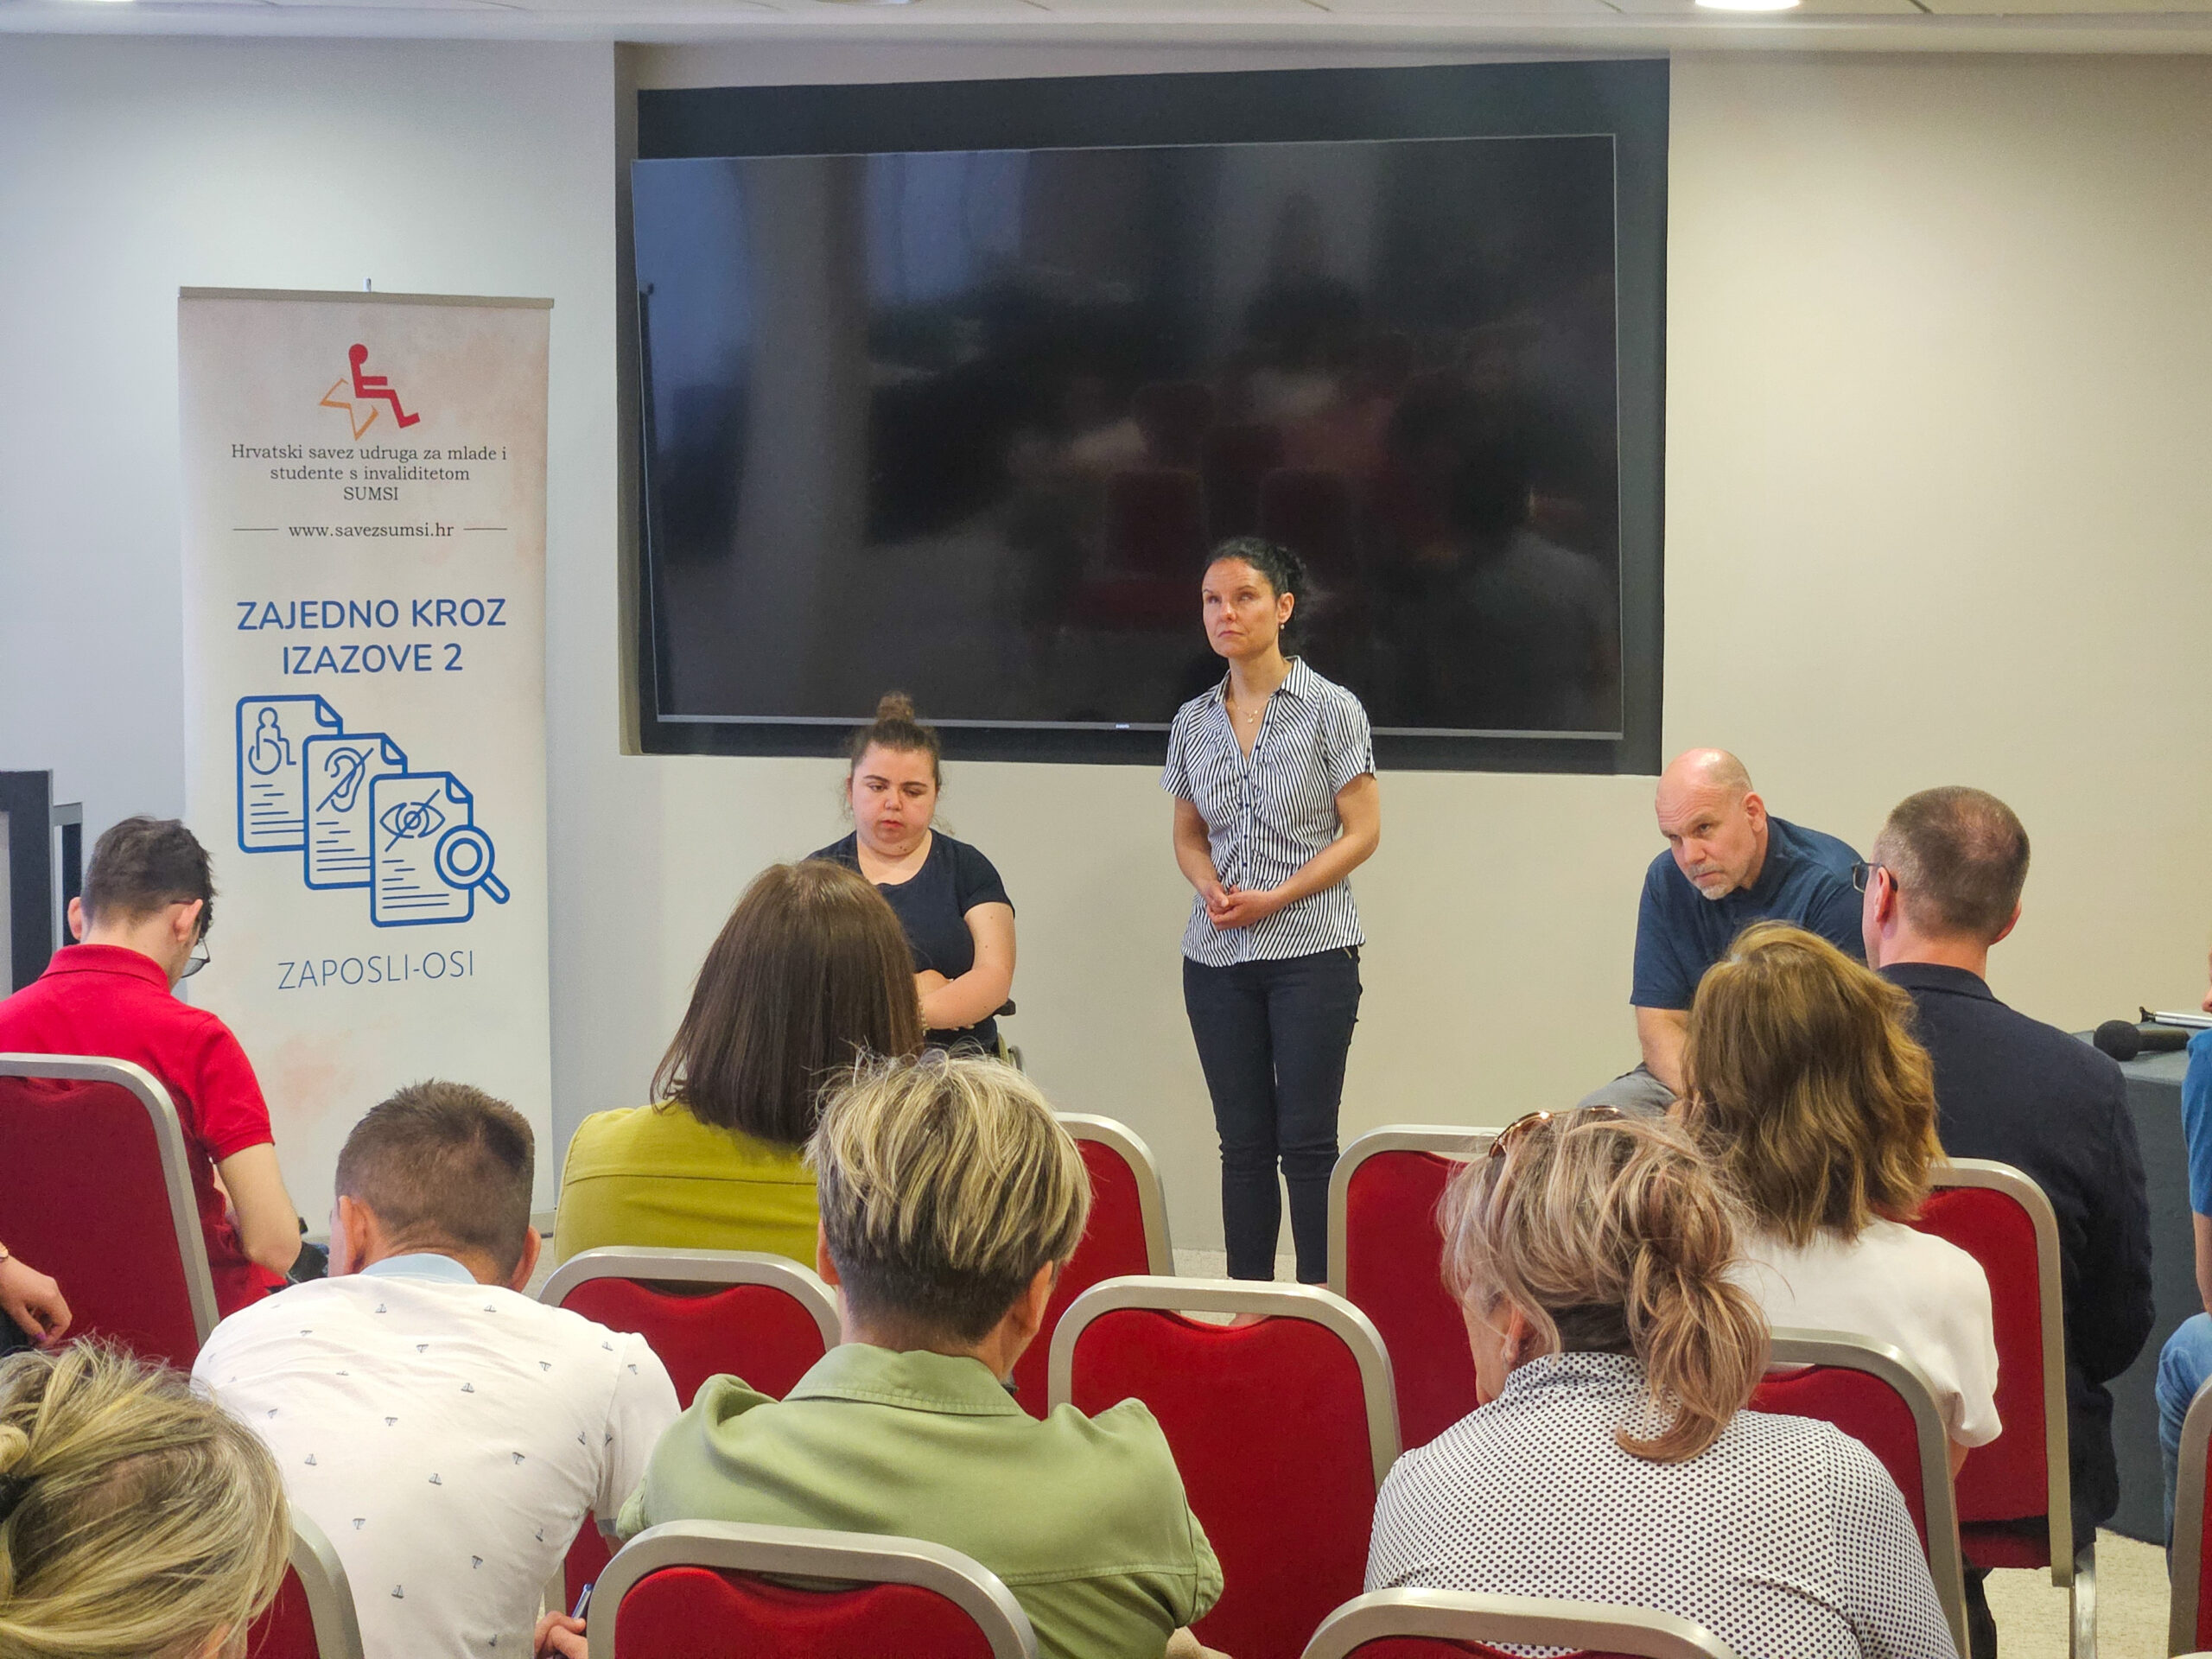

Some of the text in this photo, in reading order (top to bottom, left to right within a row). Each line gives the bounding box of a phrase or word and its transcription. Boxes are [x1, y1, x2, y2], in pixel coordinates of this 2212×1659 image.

[231, 444, 507, 464] Hrvatski savez udruga za mlade i
[270, 466, 470, 480] studente s invaliditetom
[343, 486, 399, 501] SUMSI
[289, 523, 454, 537] www.savezsumsi.hr
[237, 598, 507, 630] ZAJEDNO KROZ
[283, 643, 464, 674] IZAZOVE 2
[277, 950, 474, 990] ZAPOSLI-OSI
